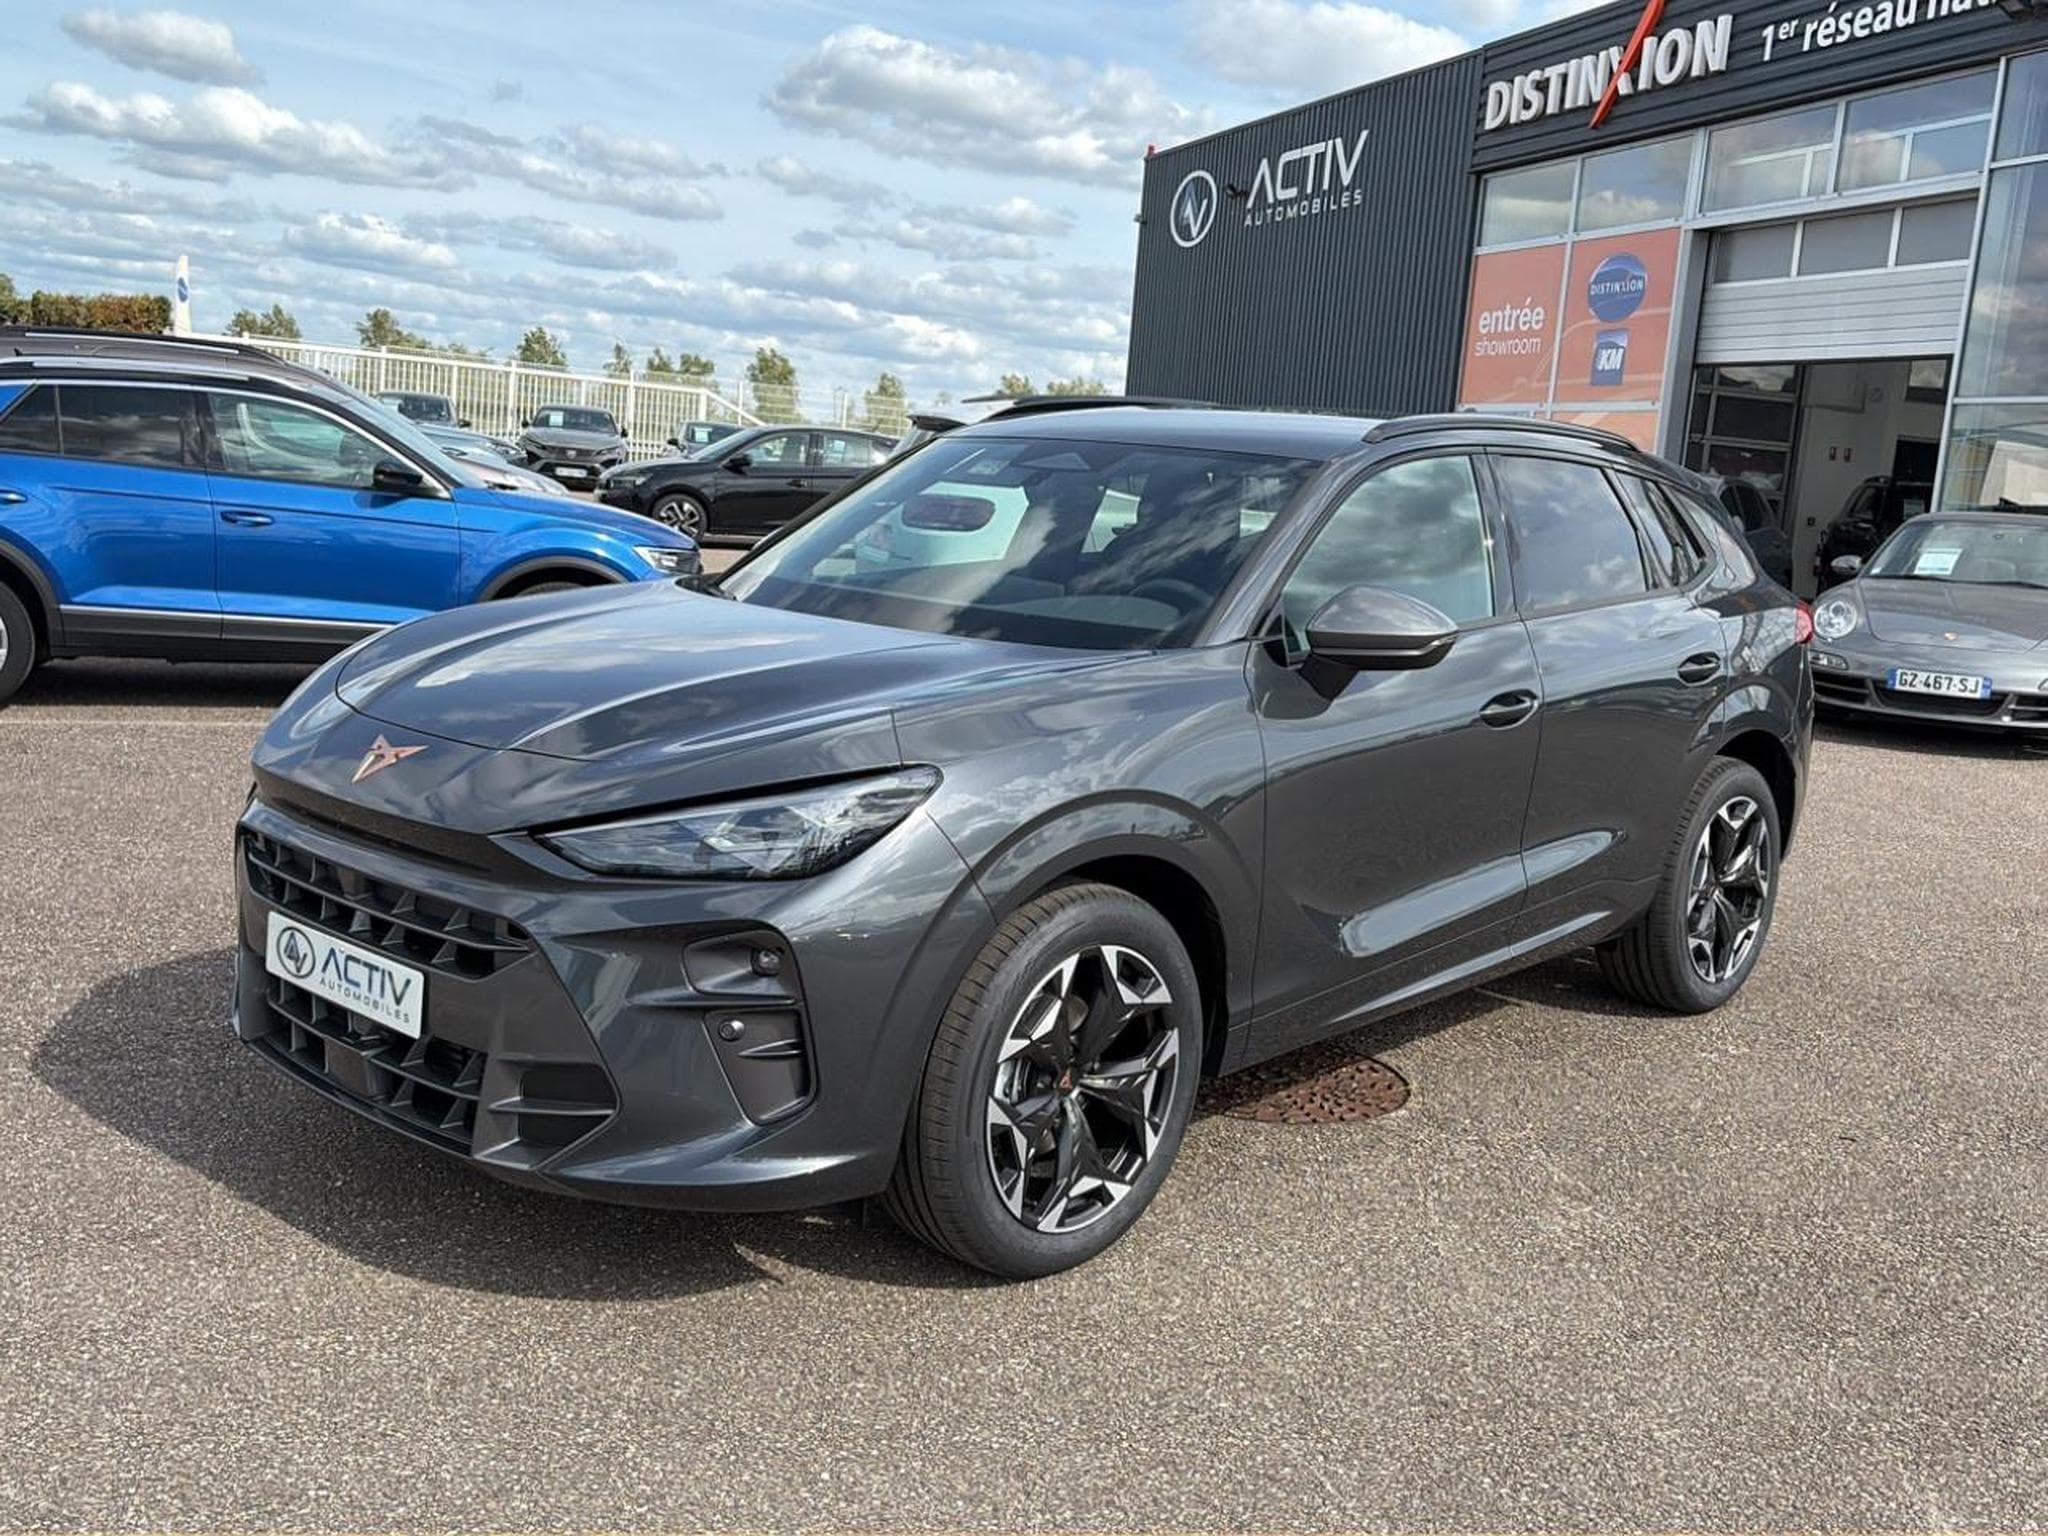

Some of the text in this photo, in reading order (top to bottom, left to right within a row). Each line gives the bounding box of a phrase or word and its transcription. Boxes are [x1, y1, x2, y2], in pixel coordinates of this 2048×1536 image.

[1802, 0, 1916, 51] réseau
[1246, 129, 1369, 209] ACTIV
[1244, 189, 1362, 227] AUTOMOBILES
[1479, 296, 1544, 334] entrée
[1475, 336, 1541, 357] showroom
[322, 947, 412, 1006] ACTIV
[319, 978, 410, 1023] AUTOMOBILES
